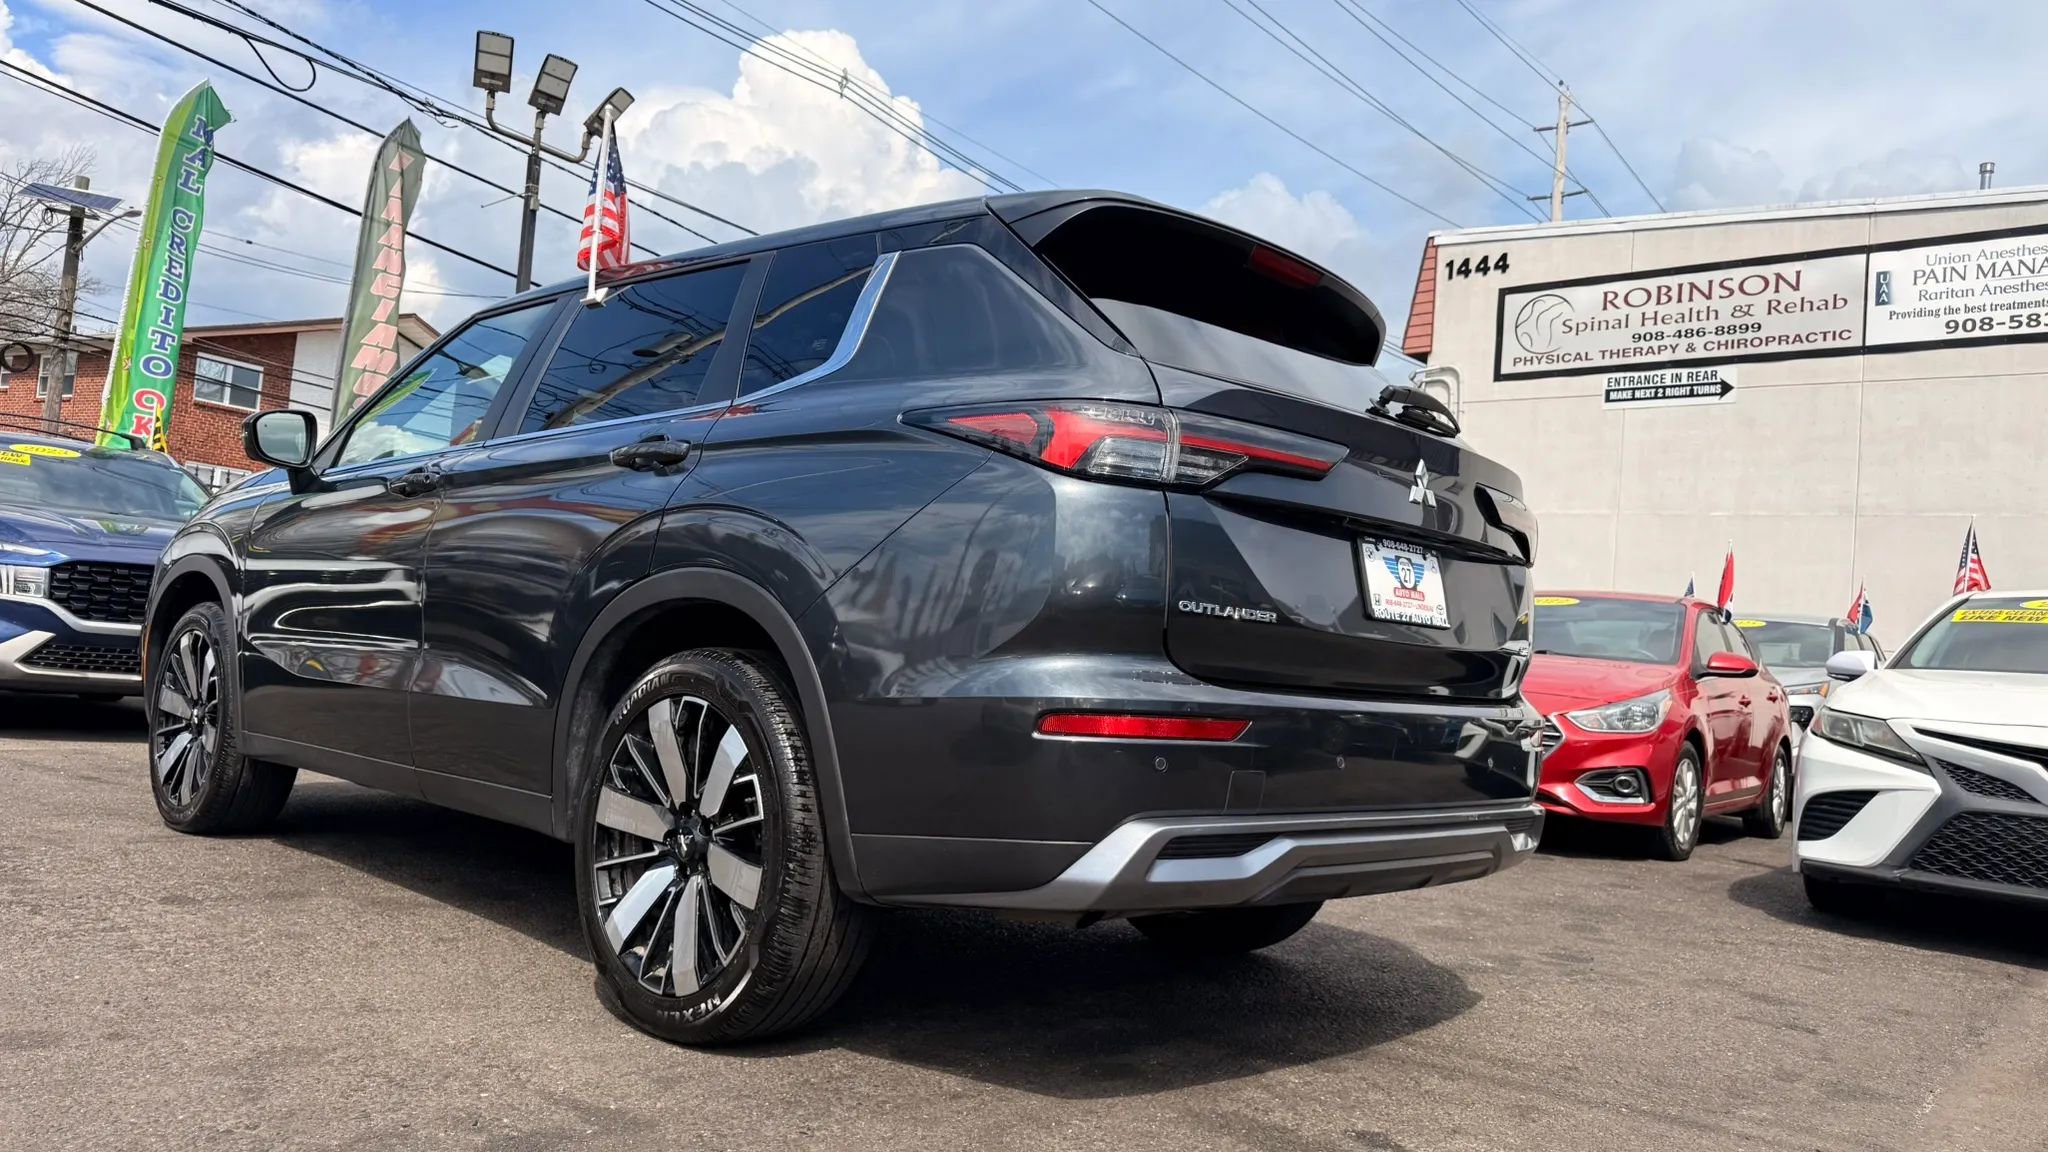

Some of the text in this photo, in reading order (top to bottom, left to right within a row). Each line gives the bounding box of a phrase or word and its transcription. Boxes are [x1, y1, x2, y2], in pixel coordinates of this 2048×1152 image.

[1445, 252, 1510, 281] 1444
[1926, 243, 2048, 267] Union Anesthes
[1913, 265, 1968, 286] PAIN
[140, 207, 196, 379] CREDITO
[1602, 270, 1802, 311] ROBINSON
[1878, 273, 1891, 303] UAA
[1918, 287, 1975, 302] Raritan
[1561, 293, 1849, 336] Spinal Health & Rehab
[1888, 306, 1941, 321] Providing
[1943, 305, 1961, 315] the
[1964, 302, 1987, 314] best
[1631, 322, 1762, 344] 908-486-8899
[1512, 329, 1853, 367] PHYSICAL THERAPY & CHIROPRACTIC
[1607, 370, 1718, 388] ENTRANCE IN REAR
[1609, 384, 1722, 400] MAKE NEXT 2 RIGHT TURNS
[1401, 567, 1412, 584] 27
[1179, 600, 1277, 623] OUTLANDER
